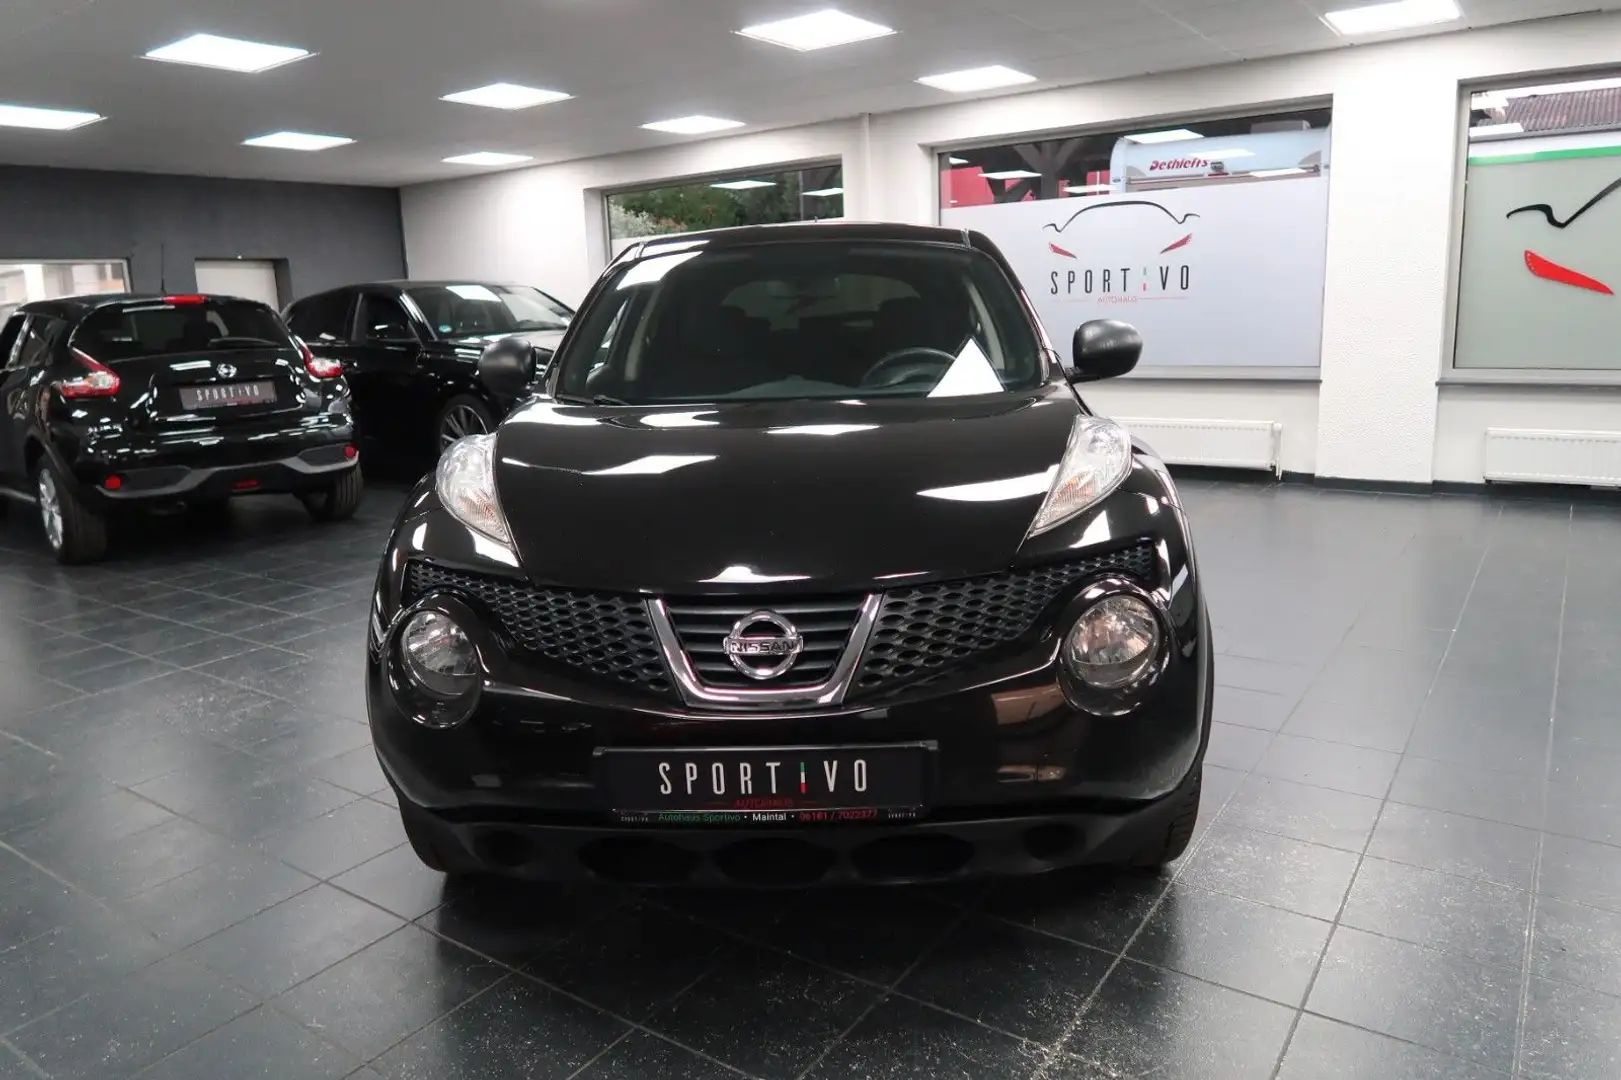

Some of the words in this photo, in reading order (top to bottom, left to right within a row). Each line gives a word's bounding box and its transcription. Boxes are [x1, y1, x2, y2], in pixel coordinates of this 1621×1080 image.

[1051, 265, 1189, 295] SPORTIVO
[731, 641, 794, 652] NISSAN
[658, 759, 867, 794] SPORTIVO
[658, 812, 698, 822] Autohaus
[704, 812, 740, 823] Sportivo
[752, 811, 787, 821] Maintal
